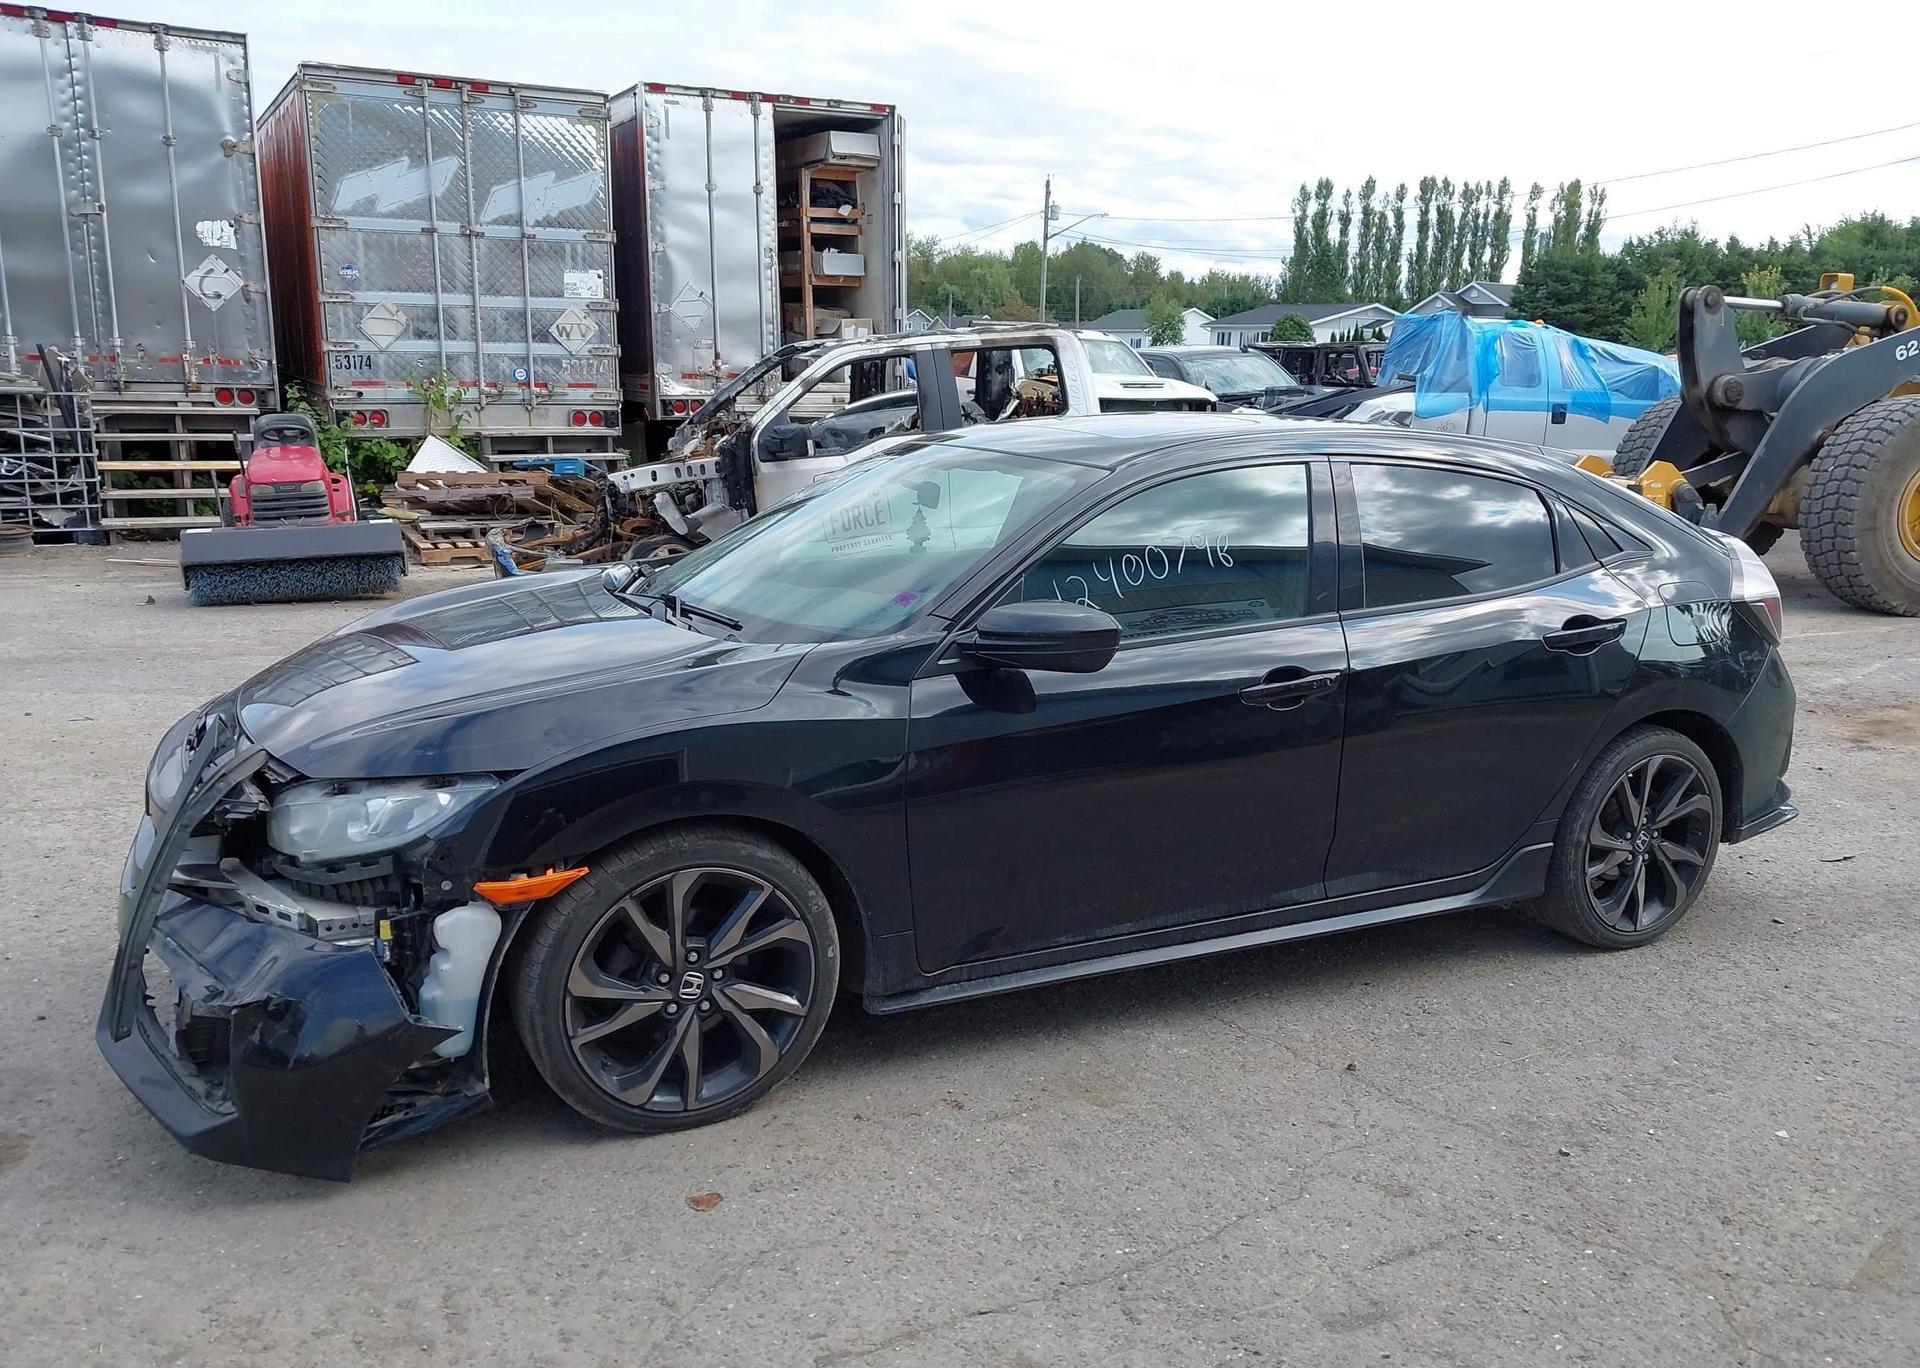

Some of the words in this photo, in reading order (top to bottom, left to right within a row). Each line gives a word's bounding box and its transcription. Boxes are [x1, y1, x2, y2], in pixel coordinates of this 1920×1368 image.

[1895, 339, 1920, 361] 62
[334, 354, 372, 370] 53174
[830, 500, 887, 536] FORCE
[831, 541, 861, 553] PROPERTY
